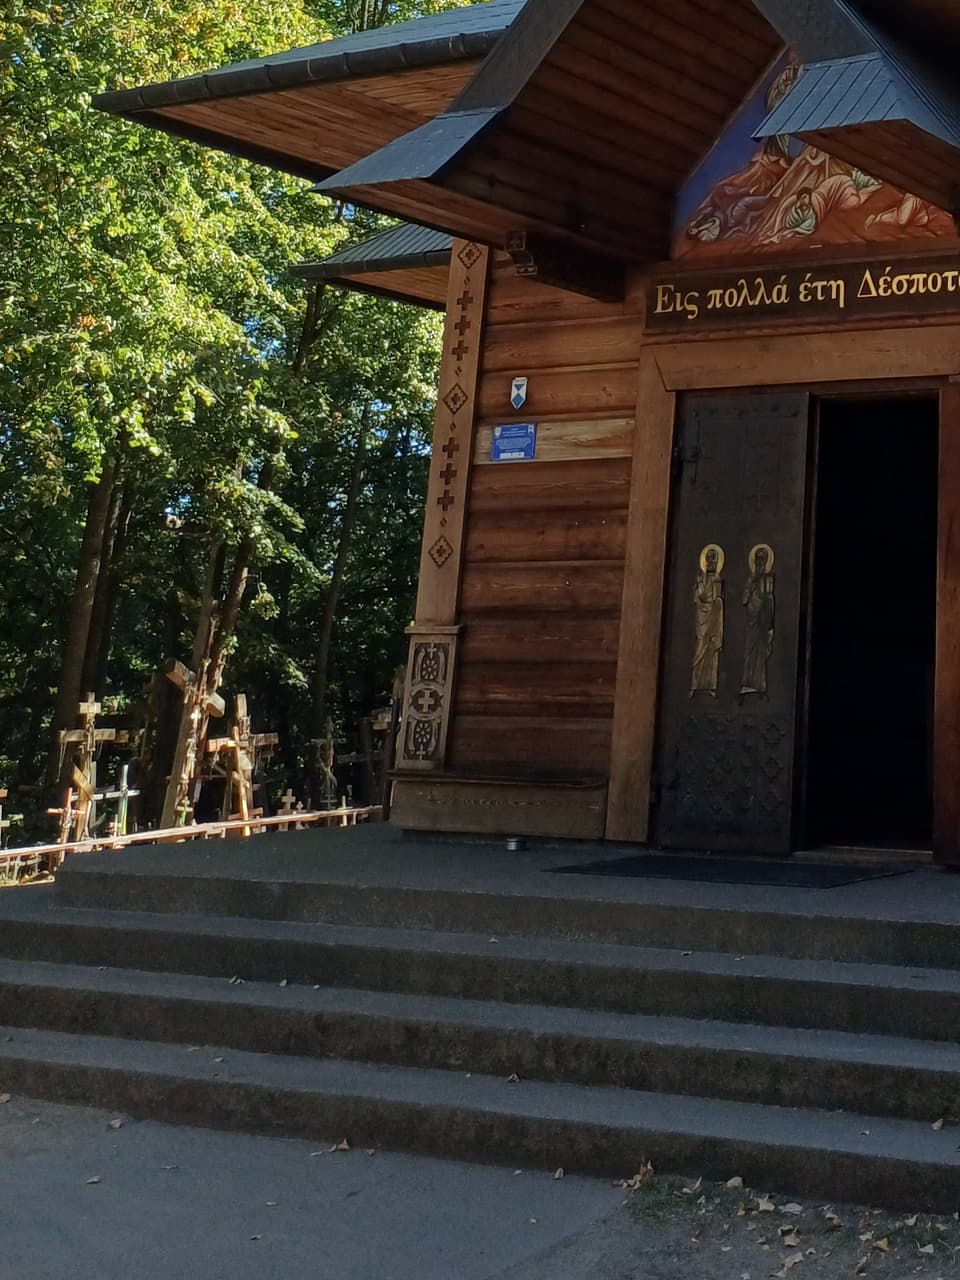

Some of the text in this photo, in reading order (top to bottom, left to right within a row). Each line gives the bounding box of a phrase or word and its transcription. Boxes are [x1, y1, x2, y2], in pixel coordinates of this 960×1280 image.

[653, 283, 699, 319] Εις
[707, 274, 790, 309] πολλά
[799, 273, 845, 308] έτη
